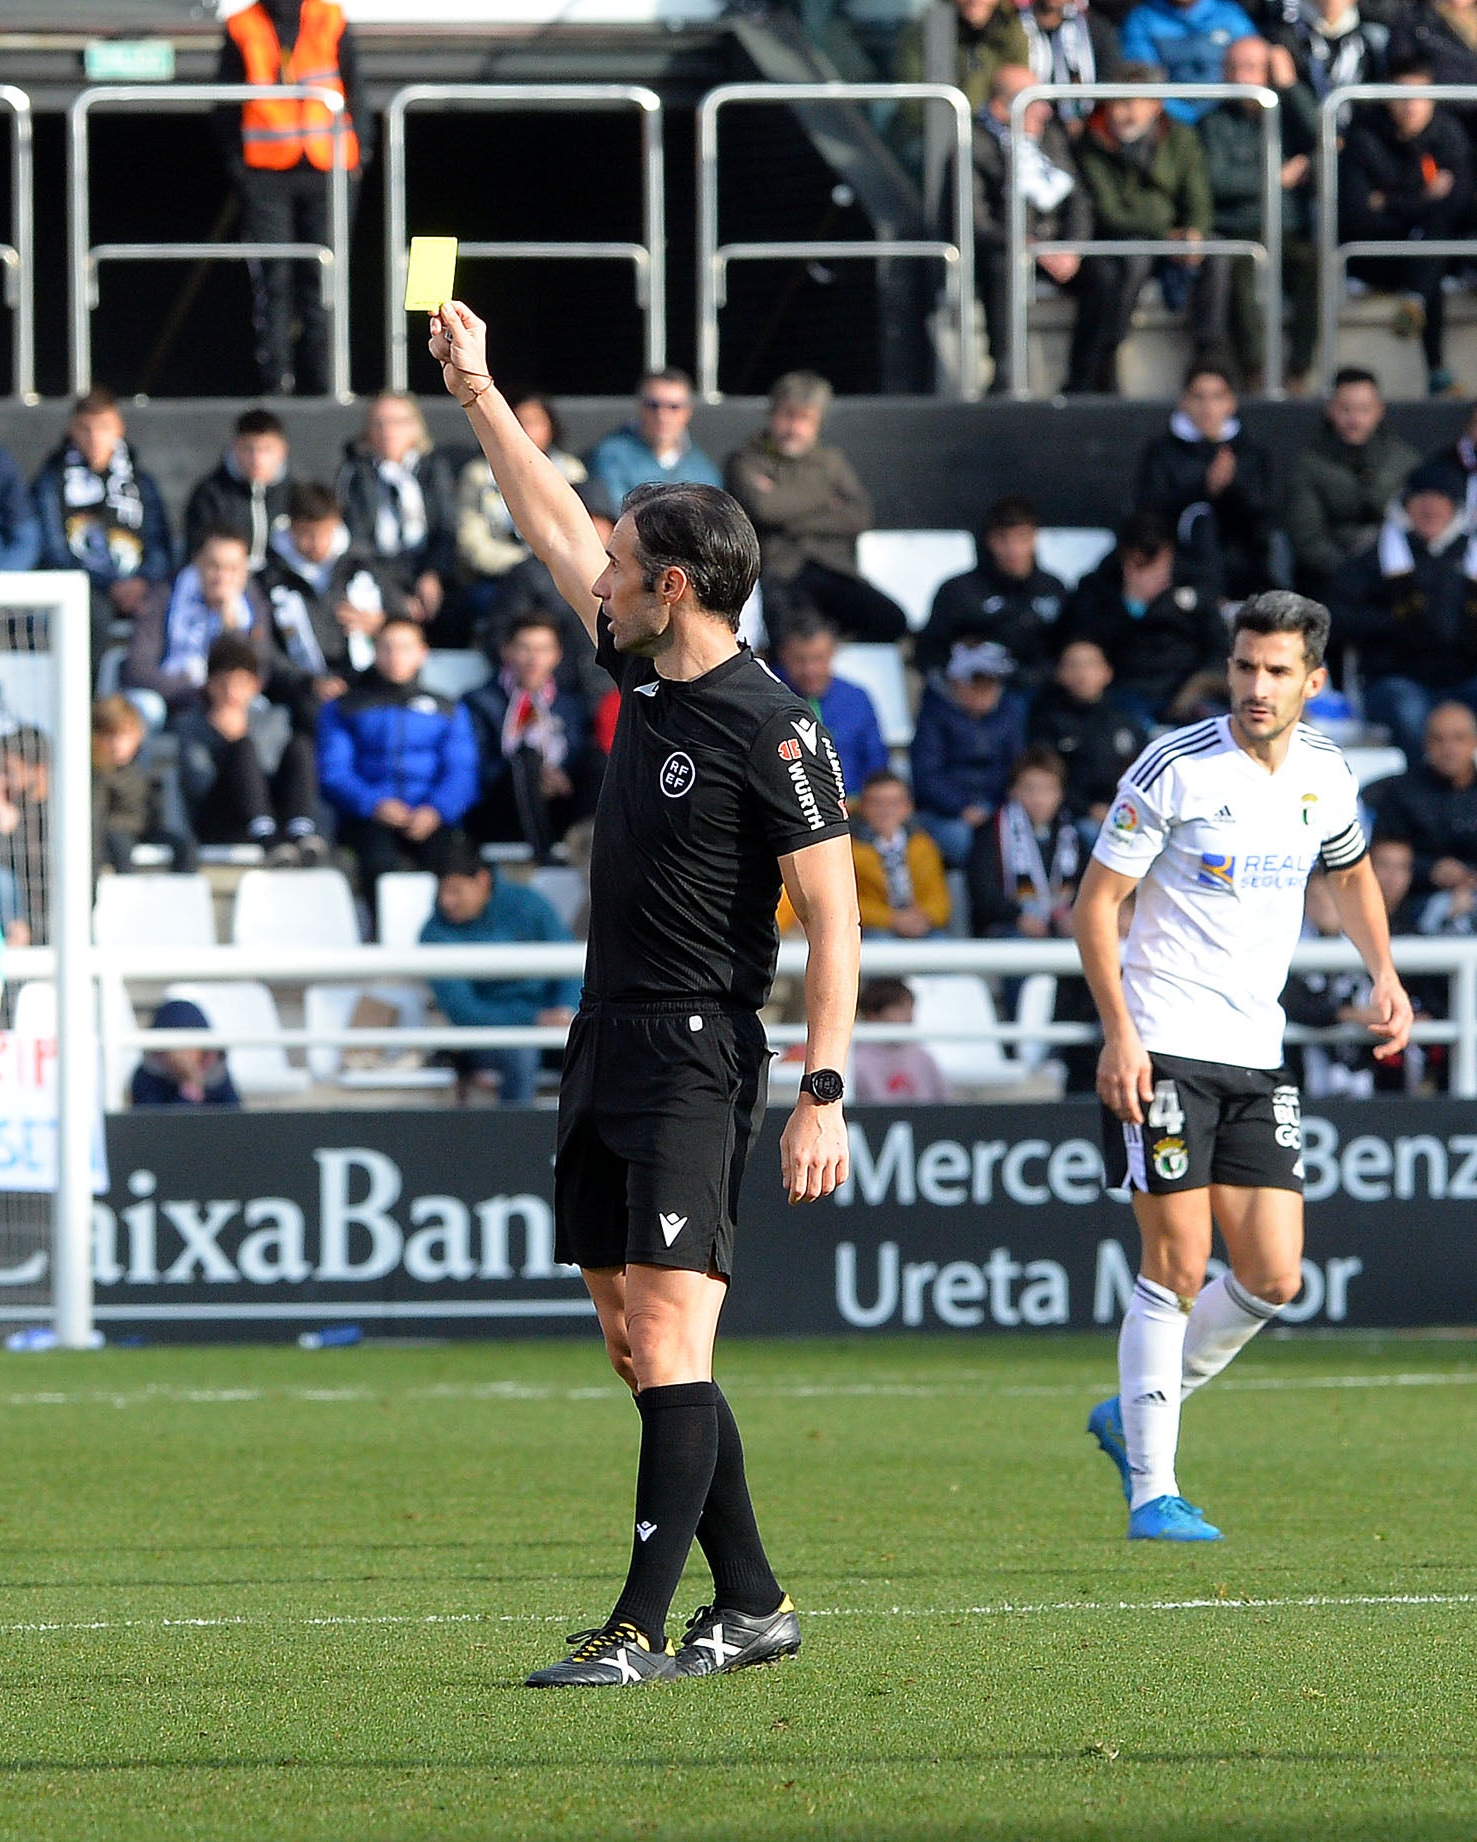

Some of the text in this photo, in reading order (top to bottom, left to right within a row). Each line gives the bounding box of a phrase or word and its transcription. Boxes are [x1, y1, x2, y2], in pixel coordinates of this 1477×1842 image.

[665, 772, 685, 788] EF
[670, 760, 690, 776] RF
[788, 761, 825, 831] WÜRTH
[1241, 875, 1306, 889] SEGUR
[1148, 1079, 1186, 1135] 4
[835, 1241, 1069, 1328] Ureta
[1093, 1238, 1363, 1323] Mor
